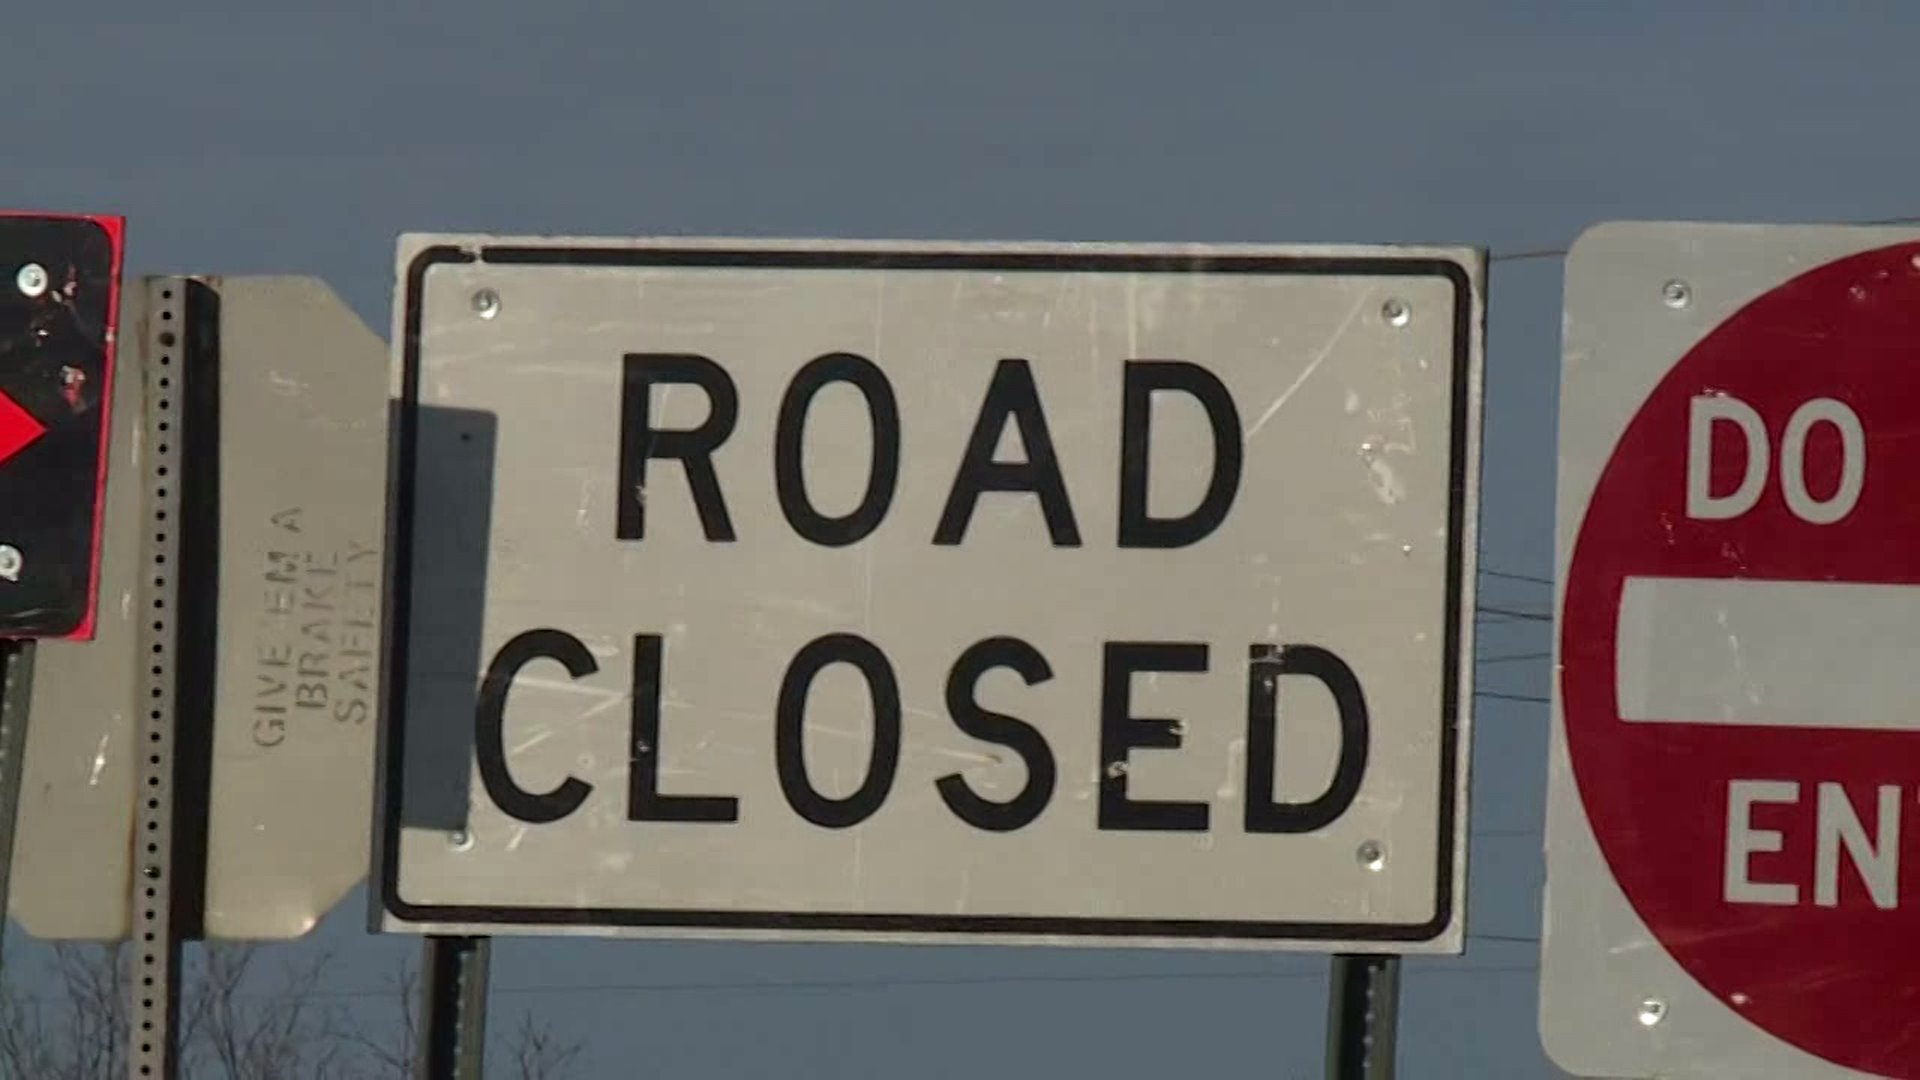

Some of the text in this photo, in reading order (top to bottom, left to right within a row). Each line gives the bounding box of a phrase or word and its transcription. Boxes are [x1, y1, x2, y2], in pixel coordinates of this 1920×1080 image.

[269, 505, 303, 533] A
[615, 352, 1244, 549] ROAD
[1686, 394, 1867, 524] DO
[252, 645, 294, 748] GIVE
[295, 551, 338, 709] BRAKE
[333, 541, 379, 726] SAFETY
[475, 627, 1370, 835] CLOSED
[1724, 779, 1919, 909] EN
